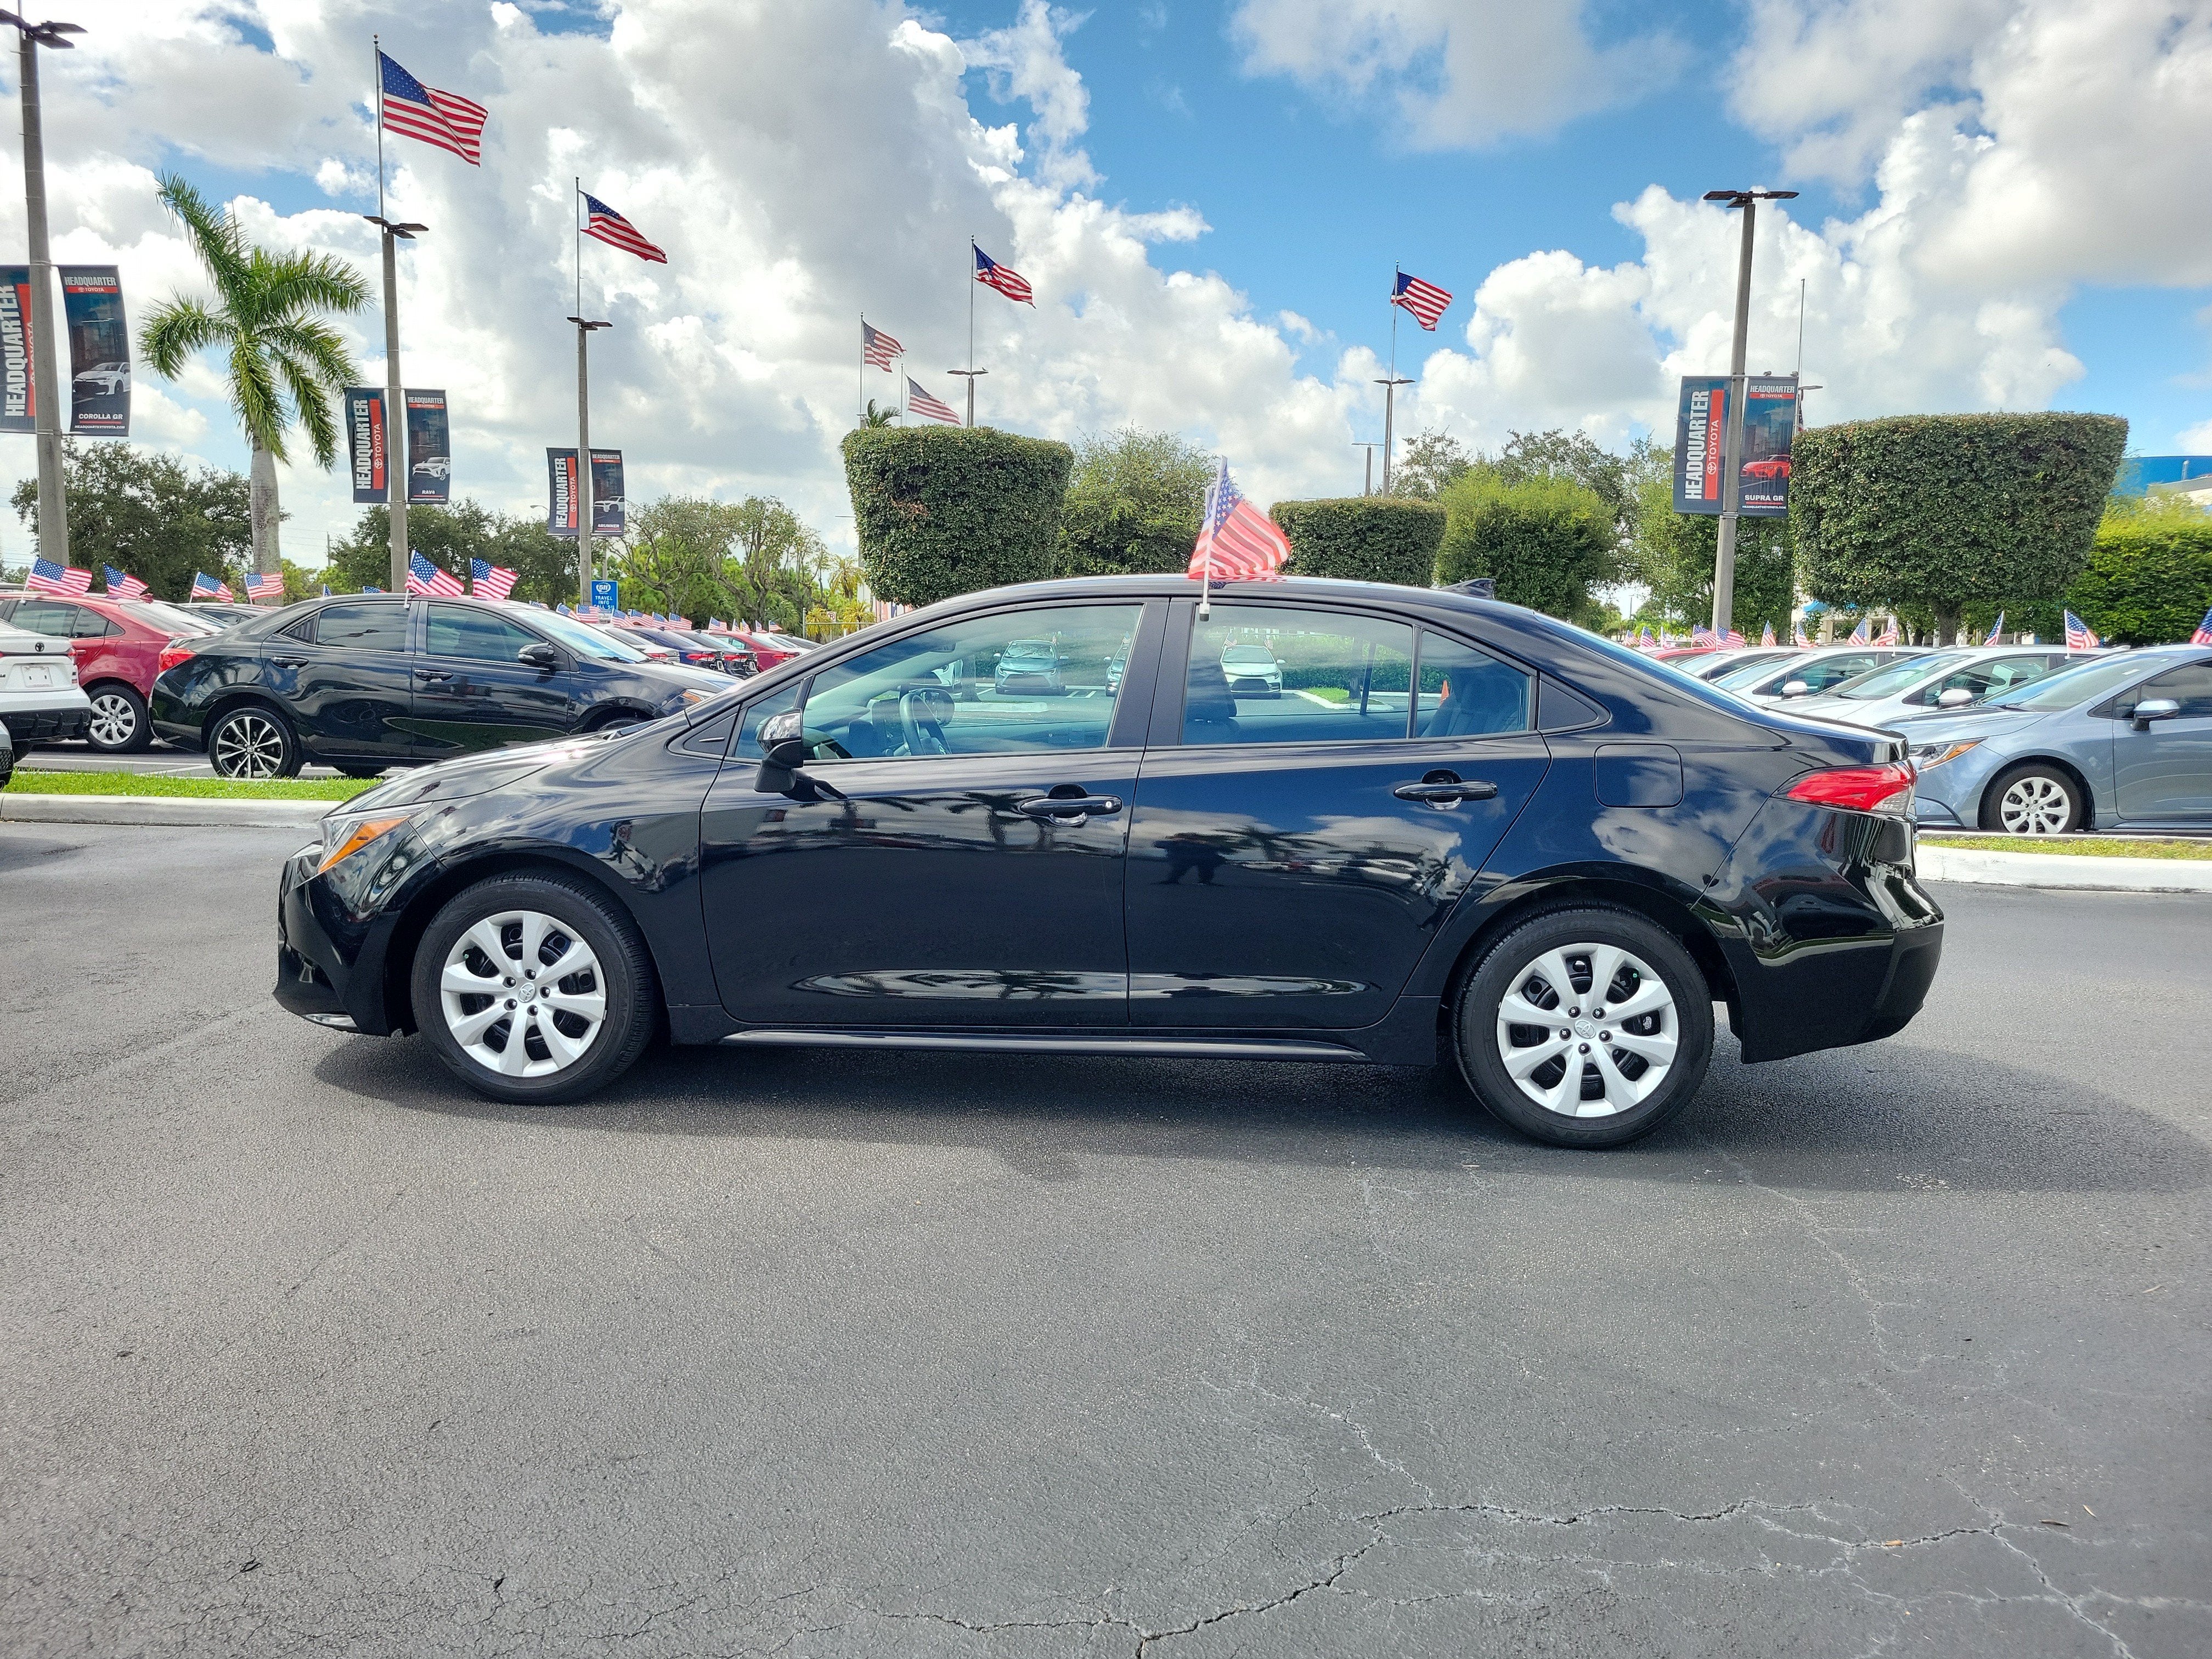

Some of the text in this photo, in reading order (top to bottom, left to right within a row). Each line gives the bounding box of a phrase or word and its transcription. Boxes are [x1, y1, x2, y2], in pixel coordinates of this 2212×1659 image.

[64, 276, 117, 287] HEADQUARTER
[0, 284, 28, 416] HEADQUARTER
[1750, 385, 1795, 393] HEADQUARTER
[354, 399, 373, 489] HEADQUARTER
[374, 424, 382, 458] TOYOTA
[1685, 391, 1709, 500] HEADQUARTER
[1708, 419, 1719, 460] TOYOTA
[555, 458, 569, 528] HEADQUARTER
